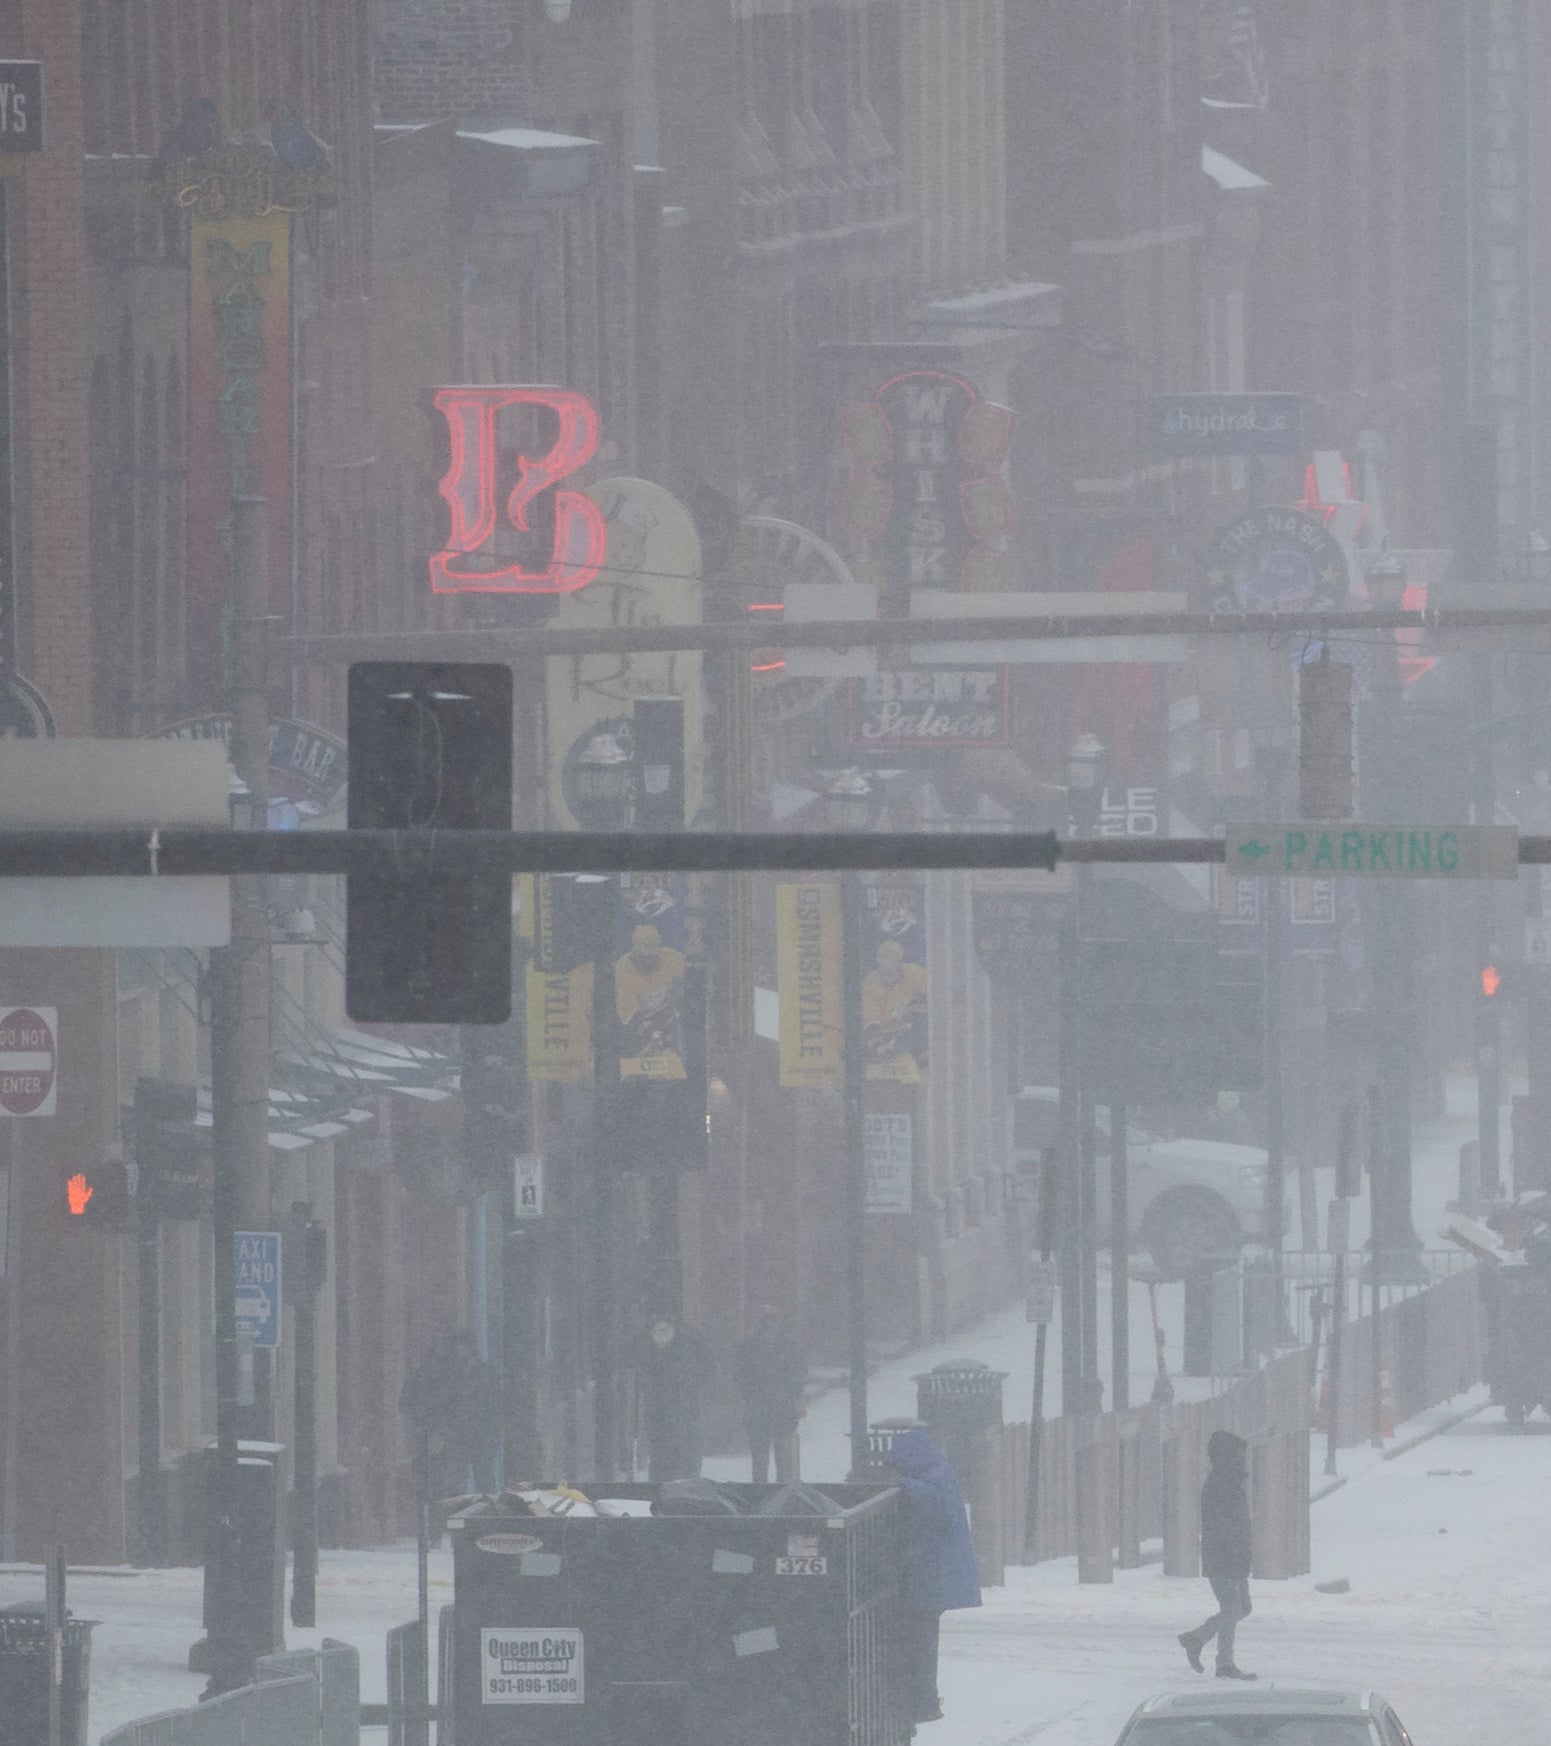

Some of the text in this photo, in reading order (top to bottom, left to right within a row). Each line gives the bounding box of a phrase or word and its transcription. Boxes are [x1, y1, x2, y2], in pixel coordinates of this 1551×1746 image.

[861, 703, 997, 741] Saloon
[291, 737, 337, 779] BAR
[1285, 831, 1460, 872] PARKING
[20, 1029, 47, 1047] NOT
[2, 1077, 42, 1094] ENTER
[780, 1558, 824, 1575] 376
[488, 1638, 577, 1660] Queen City
[503, 1659, 566, 1673] Disposal
